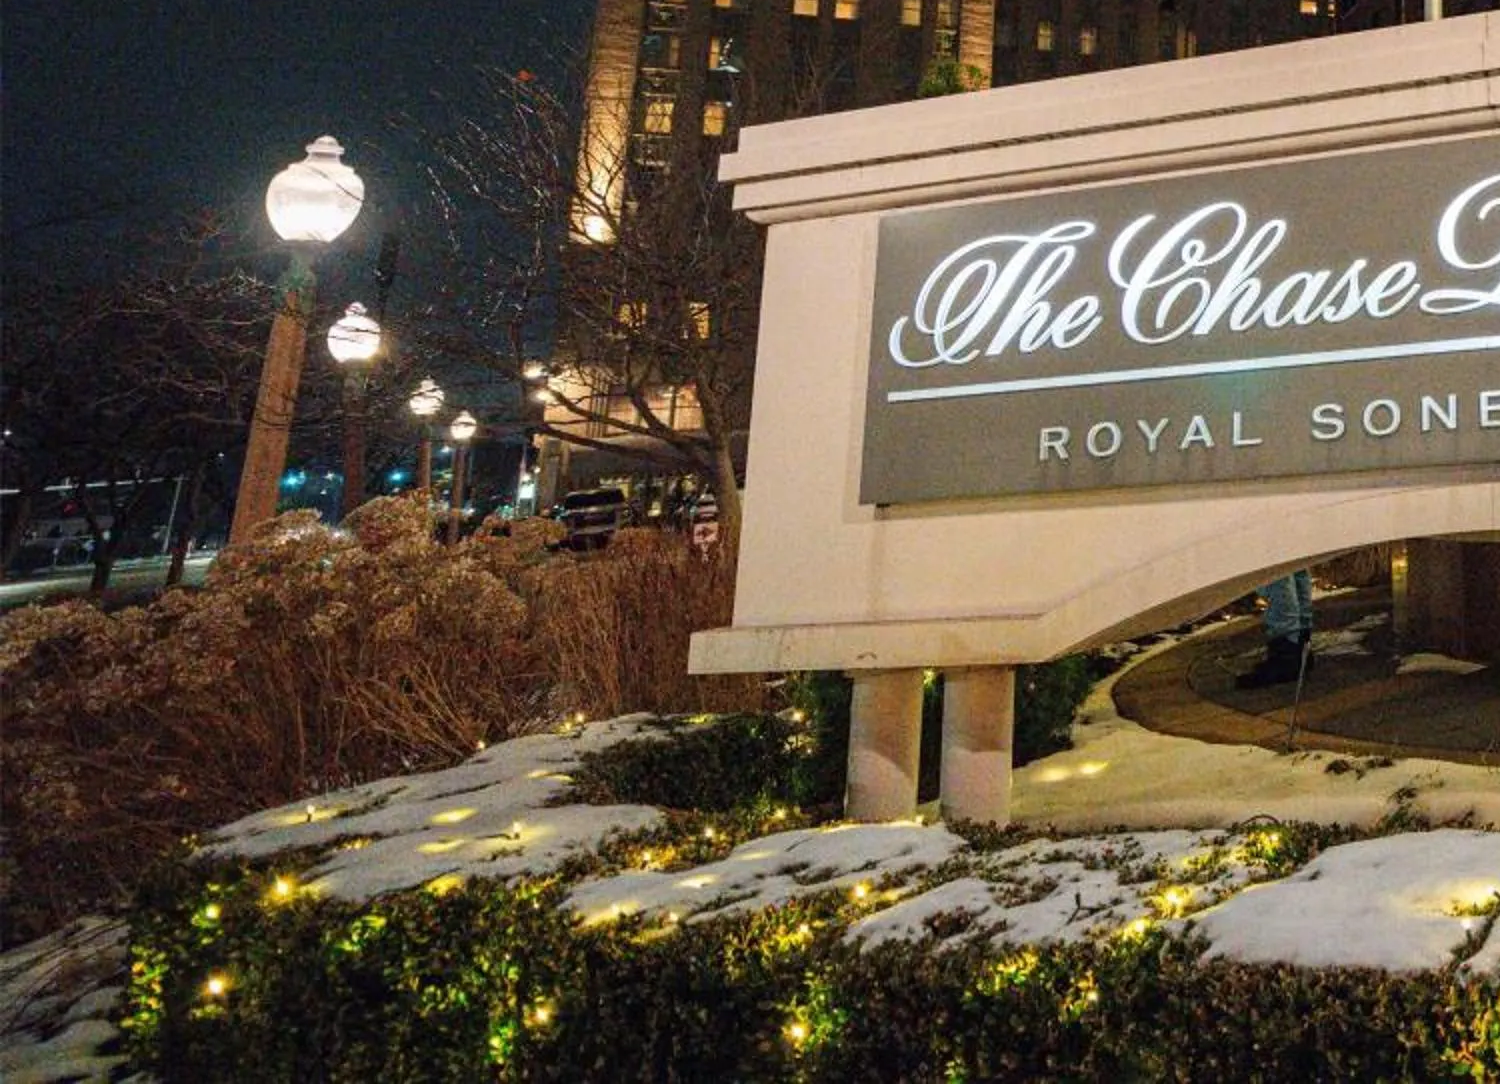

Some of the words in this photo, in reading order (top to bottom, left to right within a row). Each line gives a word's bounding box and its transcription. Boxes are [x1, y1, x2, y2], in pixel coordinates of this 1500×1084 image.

[889, 221, 1101, 368] The
[1107, 202, 1421, 344] Chase
[1038, 412, 1263, 462] ROYAL
